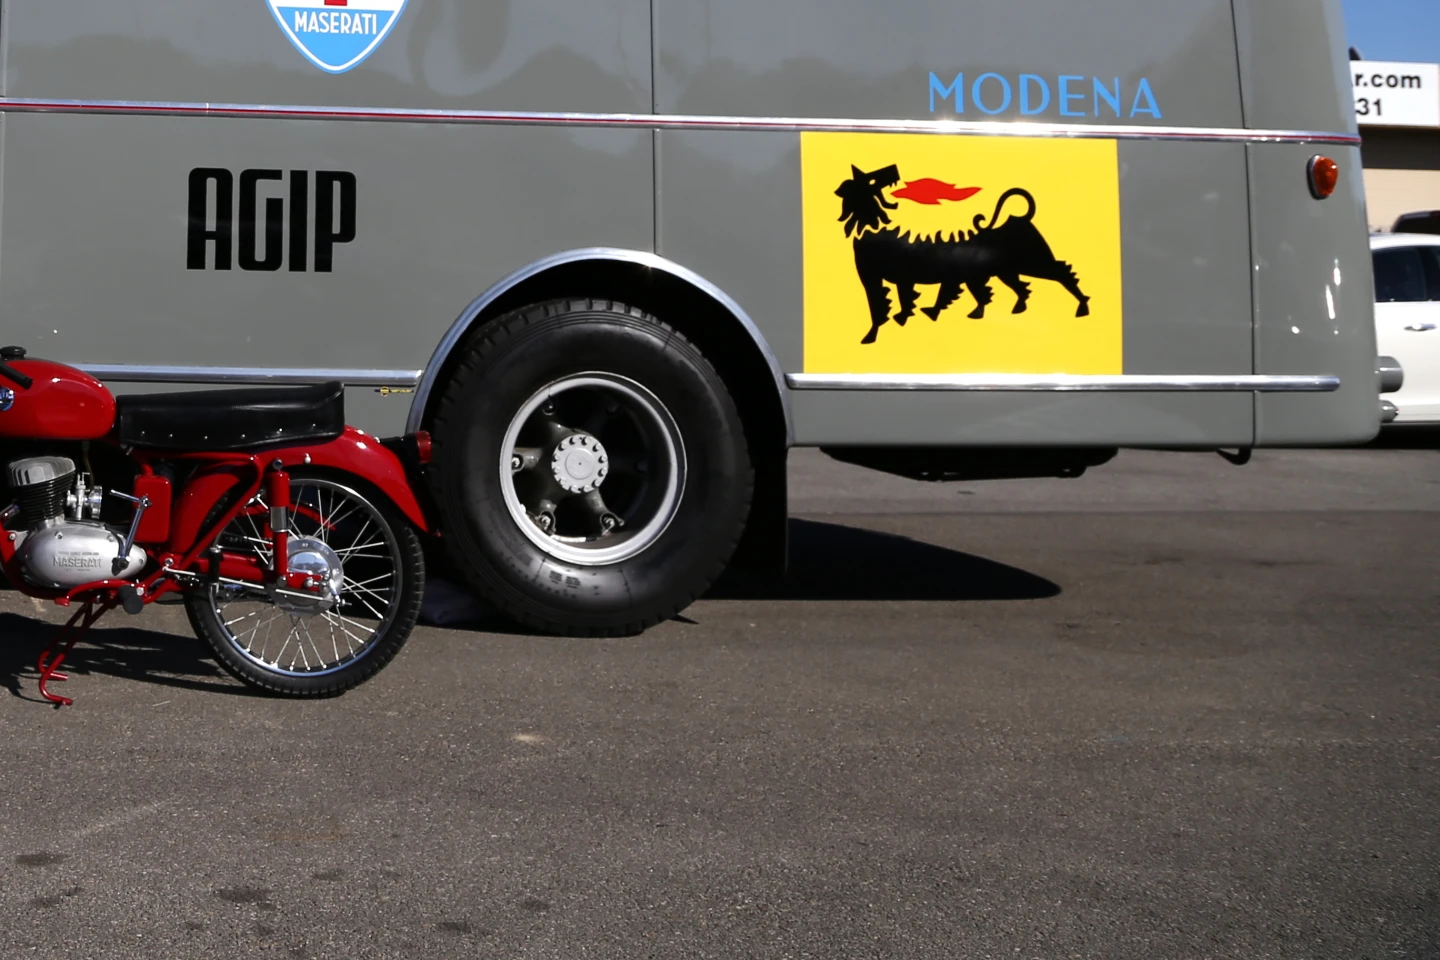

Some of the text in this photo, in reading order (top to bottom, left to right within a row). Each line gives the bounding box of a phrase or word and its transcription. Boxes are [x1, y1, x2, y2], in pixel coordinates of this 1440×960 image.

[294, 10, 378, 35] MASERATI
[928, 71, 1162, 119] MODENA
[186, 167, 357, 273] AGIP
[52, 555, 101, 568] MASERATI
